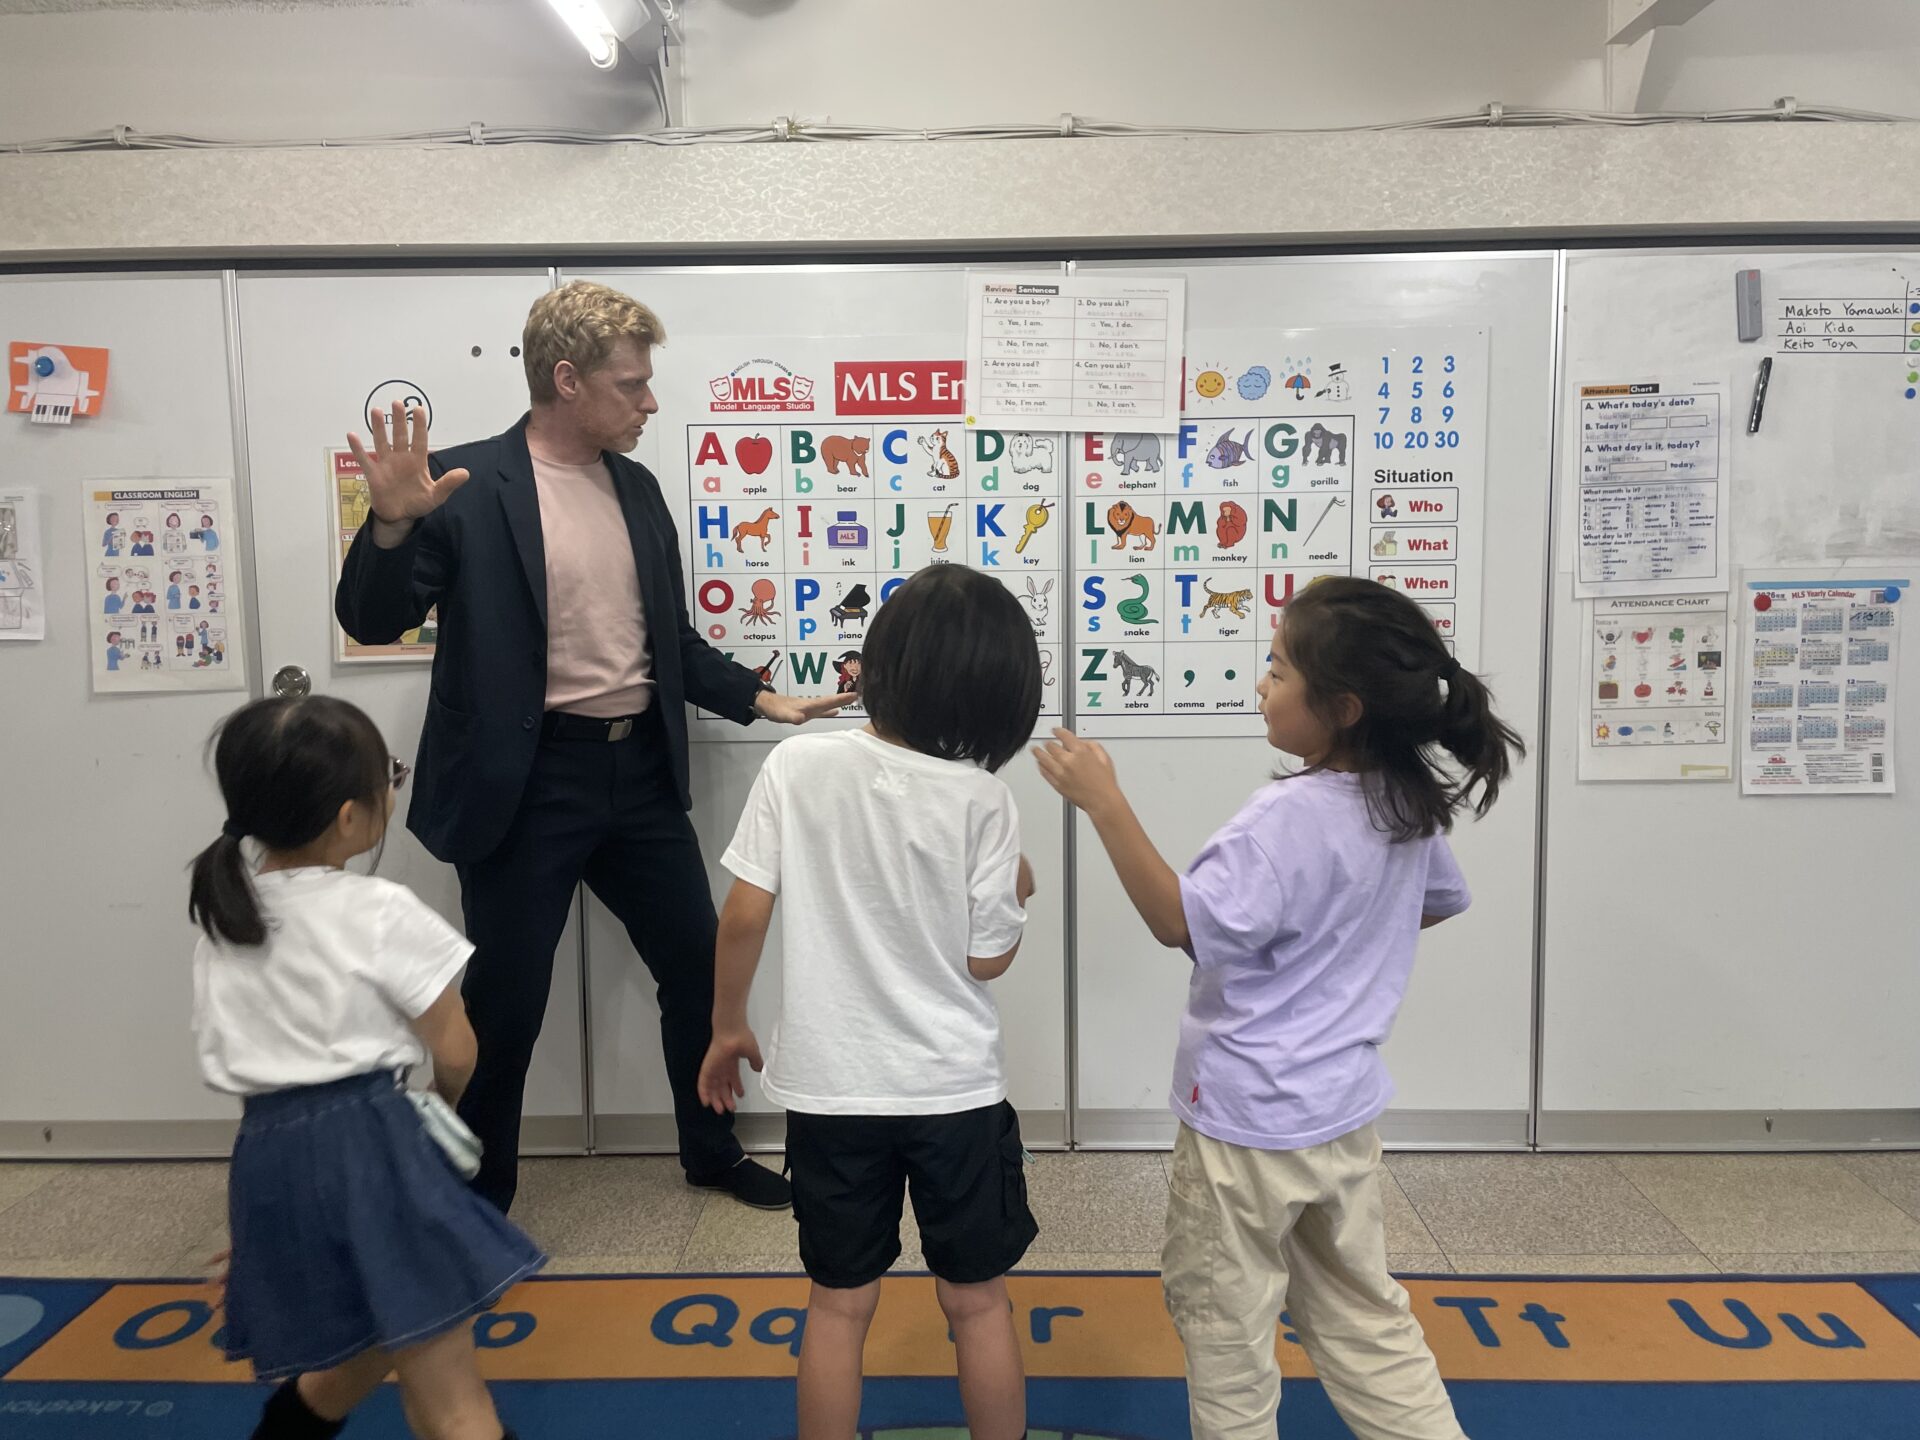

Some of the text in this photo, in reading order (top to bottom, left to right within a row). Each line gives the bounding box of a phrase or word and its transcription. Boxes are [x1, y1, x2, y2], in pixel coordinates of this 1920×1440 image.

[1018, 286, 1057, 294] Sentences
[994, 297, 1008, 305] Are
[1032, 298, 1050, 307] boy?
[1099, 300, 1113, 308] you
[1785, 302, 1903, 317] Makoto Yamawaki
[1785, 321, 1855, 334] Aoi Kida
[1784, 338, 1858, 350] Keito Toya
[733, 361, 750, 373] ENGLISH
[774, 361, 788, 373] DRAMA
[1382, 355, 1455, 374] 1 2 3
[732, 377, 791, 401] MLS
[842, 371, 966, 402] MLS En
[1378, 381, 1454, 399] 4 5 6
[1584, 385, 1653, 396] Attendance Chart
[742, 403, 780, 412] Language
[786, 402, 810, 410] Studio
[1585, 397, 1695, 410] A. What's today's date?
[1378, 405, 1454, 424] 7 8 9
[1595, 422, 1618, 430] Today
[695, 431, 728, 465] A
[791, 430, 816, 464] B
[882, 429, 908, 465] C
[976, 430, 1005, 462] D
[1084, 432, 1104, 461] E
[1178, 425, 1198, 459] F
[1264, 423, 1299, 458] G
[1373, 431, 1459, 449] 10 20 30
[1584, 440, 1700, 453] A. What day is it, today?
[340, 459, 361, 467] Les
[1595, 464, 1606, 472] It's
[795, 469, 813, 493] b
[889, 475, 902, 491] c
[981, 466, 999, 491] d
[1085, 472, 1102, 488] e
[1181, 463, 1193, 488] f
[1223, 479, 1239, 487] fish
[1272, 465, 1289, 488] g
[1310, 478, 1339, 487] gorilla
[1374, 469, 1453, 483] Situation
[703, 477, 721, 492] a
[742, 485, 767, 494] apple
[837, 484, 857, 492] bear
[932, 484, 945, 492] cat
[1022, 482, 1039, 492] dog
[1118, 481, 1156, 490] elephant
[114, 490, 197, 499] CLASSROOM ENGLISH
[1408, 500, 1443, 512] Who
[699, 506, 729, 539] H
[797, 505, 812, 538] I
[886, 504, 905, 538] J
[976, 504, 1006, 537] K
[1086, 502, 1105, 535] L
[1167, 501, 1207, 534] M
[1263, 499, 1297, 532] N
[840, 532, 856, 541] MLS
[1602, 532, 1614, 540] day
[1091, 540, 1097, 564] l
[1173, 545, 1199, 561] m
[1271, 543, 1288, 559] n
[1407, 539, 1449, 551] What
[706, 544, 723, 568] h
[803, 542, 809, 566] i
[842, 558, 855, 566] ink
[892, 539, 900, 569] j
[982, 542, 1000, 566] k
[1023, 556, 1040, 567] key
[1129, 555, 1145, 563] lion
[1212, 554, 1248, 563] monkey
[1309, 552, 1338, 560] needle
[745, 559, 769, 567] horse
[1175, 574, 1198, 607] T
[1264, 573, 1294, 607] U
[1405, 577, 1449, 589] When
[698, 579, 734, 614] O
[795, 578, 820, 612] P
[1082, 576, 1106, 610] S
[1807, 590, 1825, 598] Yearly
[1828, 590, 1856, 598] Calendar
[1611, 598, 1710, 608] ATTENDANCE CHART
[800, 617, 817, 640] p
[1088, 616, 1100, 632] s
[1181, 614, 1191, 633] t
[708, 624, 727, 640] o
[743, 632, 776, 641] octopus
[838, 631, 863, 641] piano
[1124, 628, 1150, 636] snake
[1219, 627, 1239, 637] tiger
[789, 652, 828, 685] W
[1080, 649, 1108, 681] Z
[1086, 692, 1102, 707] z
[1216, 700, 1244, 710] period
[650, 1293, 809, 1358] Qq
[1433, 1297, 1571, 1348] Tt
[1667, 1298, 1866, 1349] Uu
